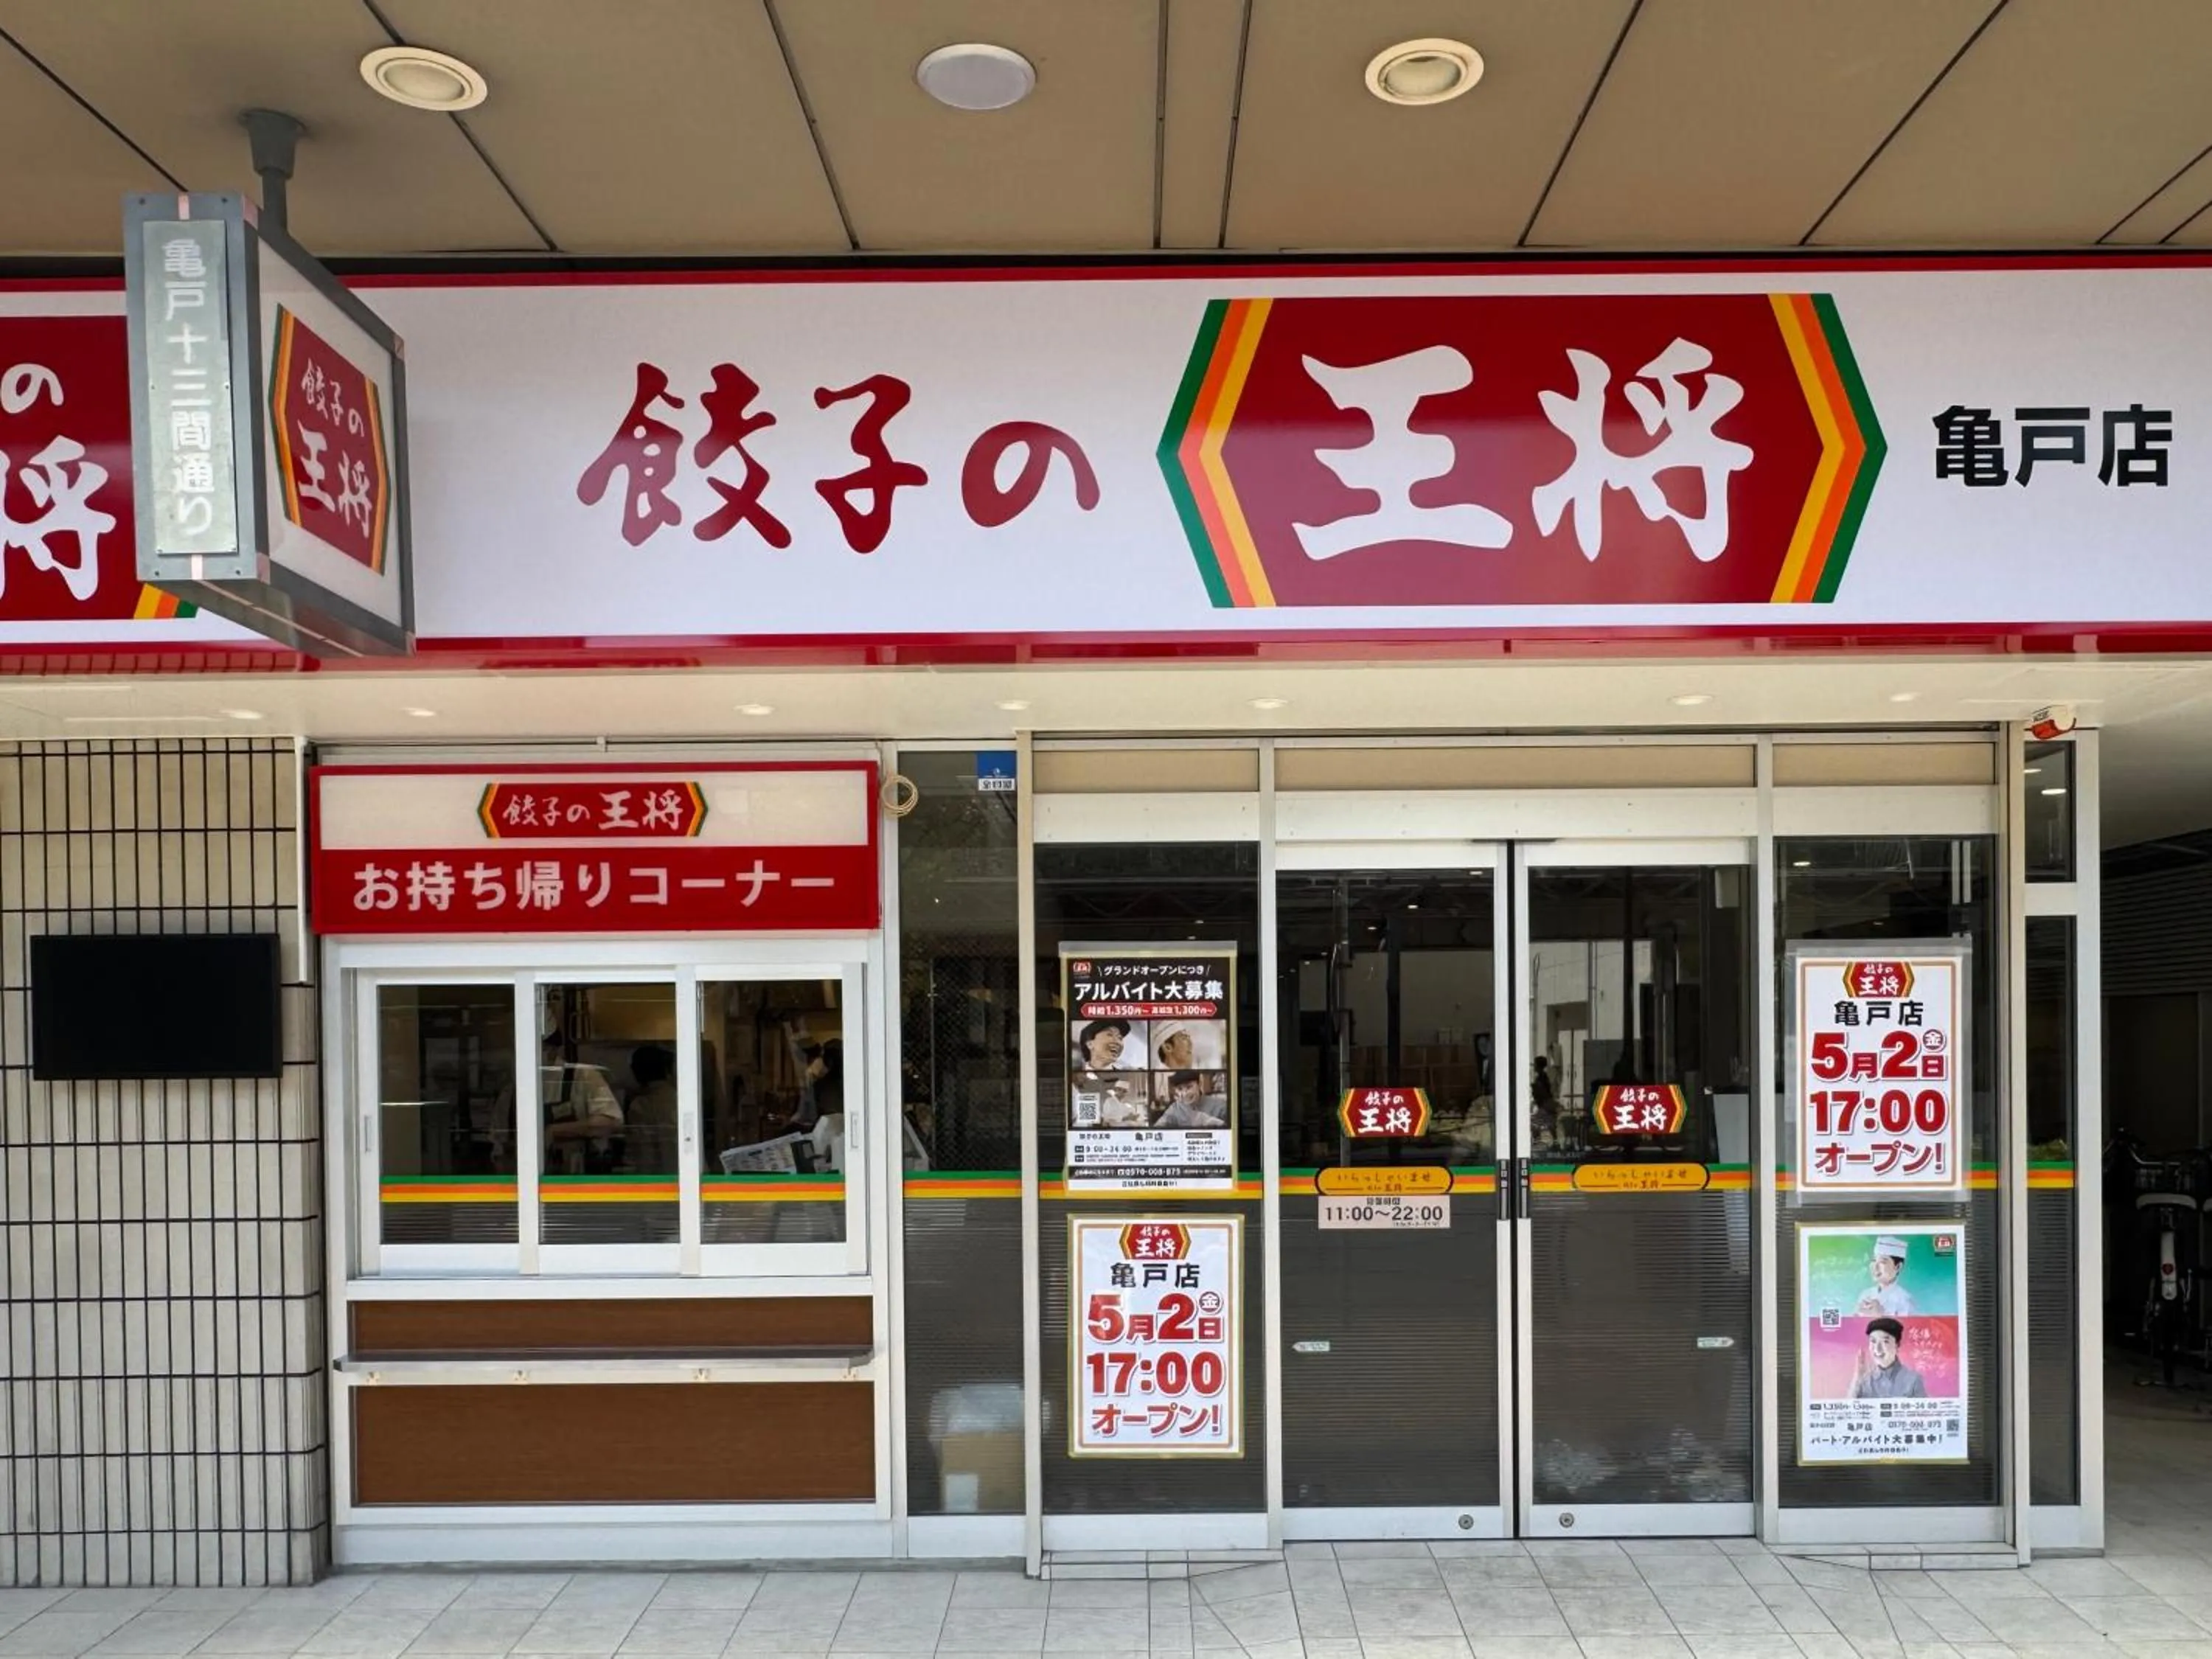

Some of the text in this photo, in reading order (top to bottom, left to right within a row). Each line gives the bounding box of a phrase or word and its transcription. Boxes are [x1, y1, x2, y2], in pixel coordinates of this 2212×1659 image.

[1, 363, 64, 414] の
[163, 239, 215, 535] 亀戸十三間通り
[302, 358, 365, 437] 餃子の
[577, 337, 2172, 563] 餃子の 王将 亀戸店
[297, 419, 372, 538] 王将
[353, 860, 835, 911] お持ち帰りコーナー
[1104, 965, 1204, 975] グランドオープンにつき
[1074, 979, 1223, 1001] アルバイト大募集
[1859, 976, 1900, 995] 王将
[1834, 1000, 1924, 1026] 亀戸店
[1365, 1091, 1404, 1105] 餃子の
[1620, 1088, 1659, 1102] 餃子の
[1358, 1107, 1413, 1133] 王将
[1613, 1103, 1667, 1130] 王将
[1810, 1090, 1946, 1133] 17:00
[1815, 1141, 1944, 1174] オープン!
[1326, 1206, 1443, 1221] 11:00～22:00
[1135, 1238, 1176, 1258] 王将
[1110, 1262, 1200, 1288] 亀戸店
[1087, 1351, 1223, 1394] 17:00
[1092, 1402, 1220, 1434] オープン!
